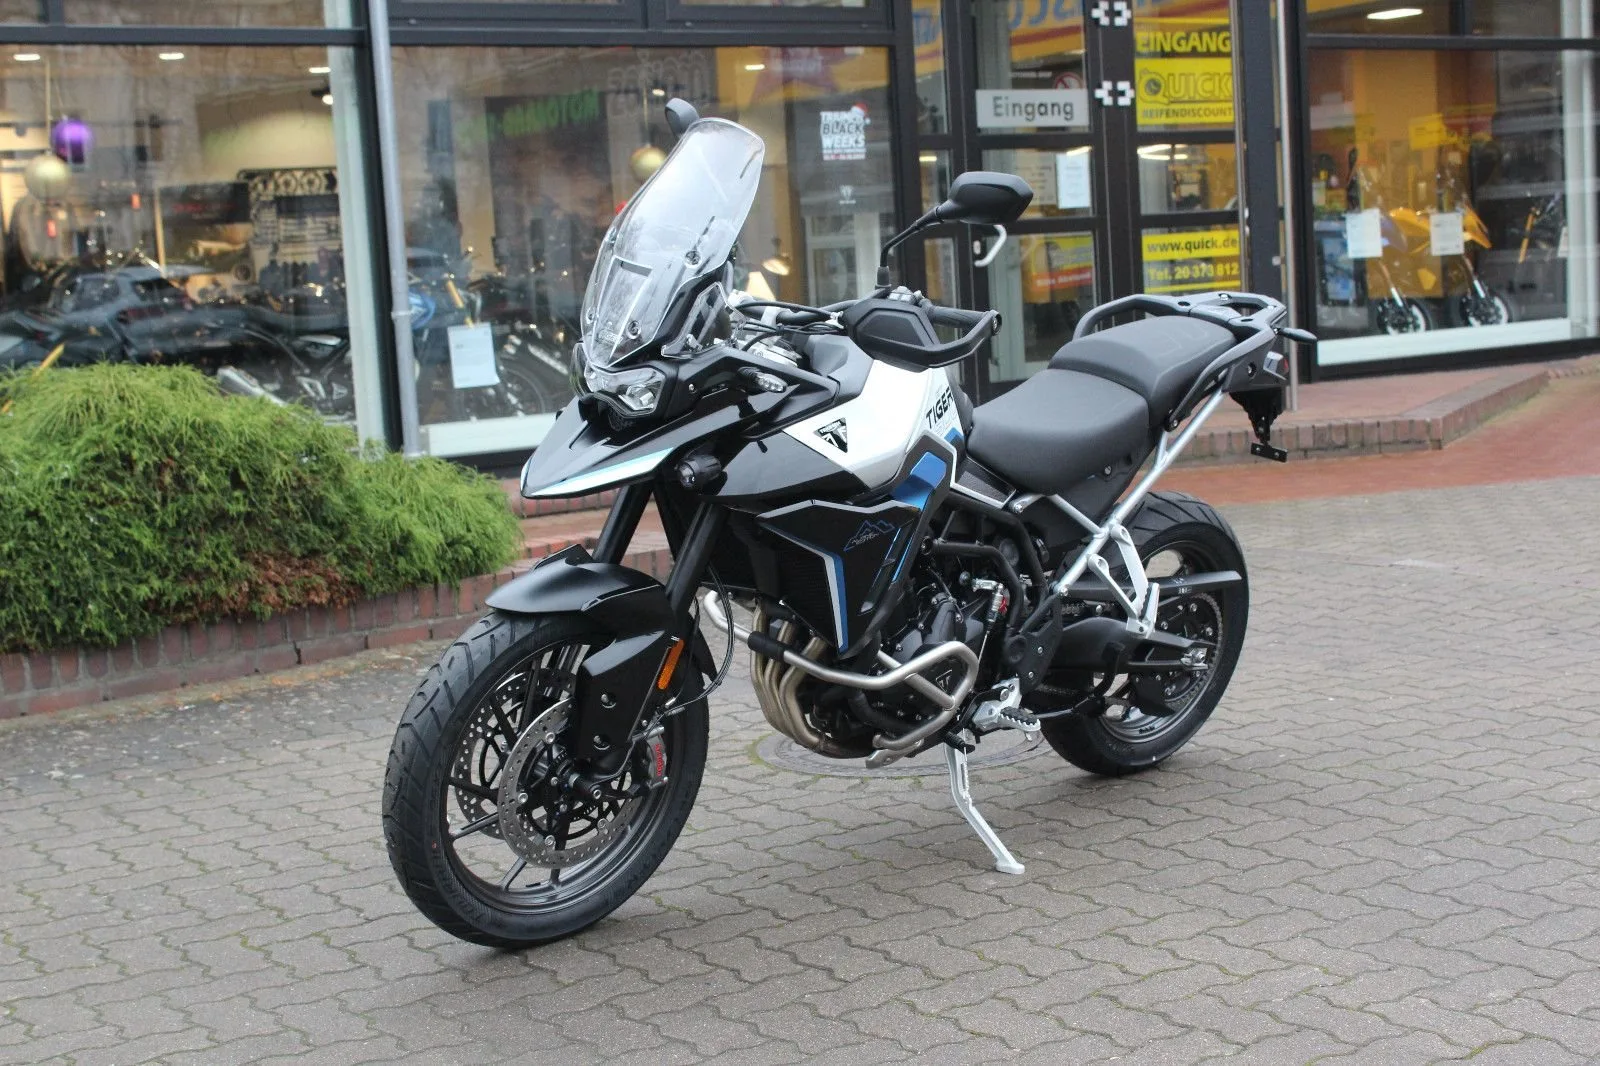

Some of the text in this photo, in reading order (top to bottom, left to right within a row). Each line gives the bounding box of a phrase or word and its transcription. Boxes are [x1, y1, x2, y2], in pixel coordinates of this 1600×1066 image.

[1136, 31, 1231, 53] EINGANG
[1139, 69, 1233, 105] QUICK
[992, 95, 1074, 122] Eingang
[1142, 106, 1232, 118] REIFENDISCOUNT
[822, 122, 863, 135] BLACK
[1147, 237, 1238, 253] www.quick.de
[926, 386, 954, 430] TIGER
